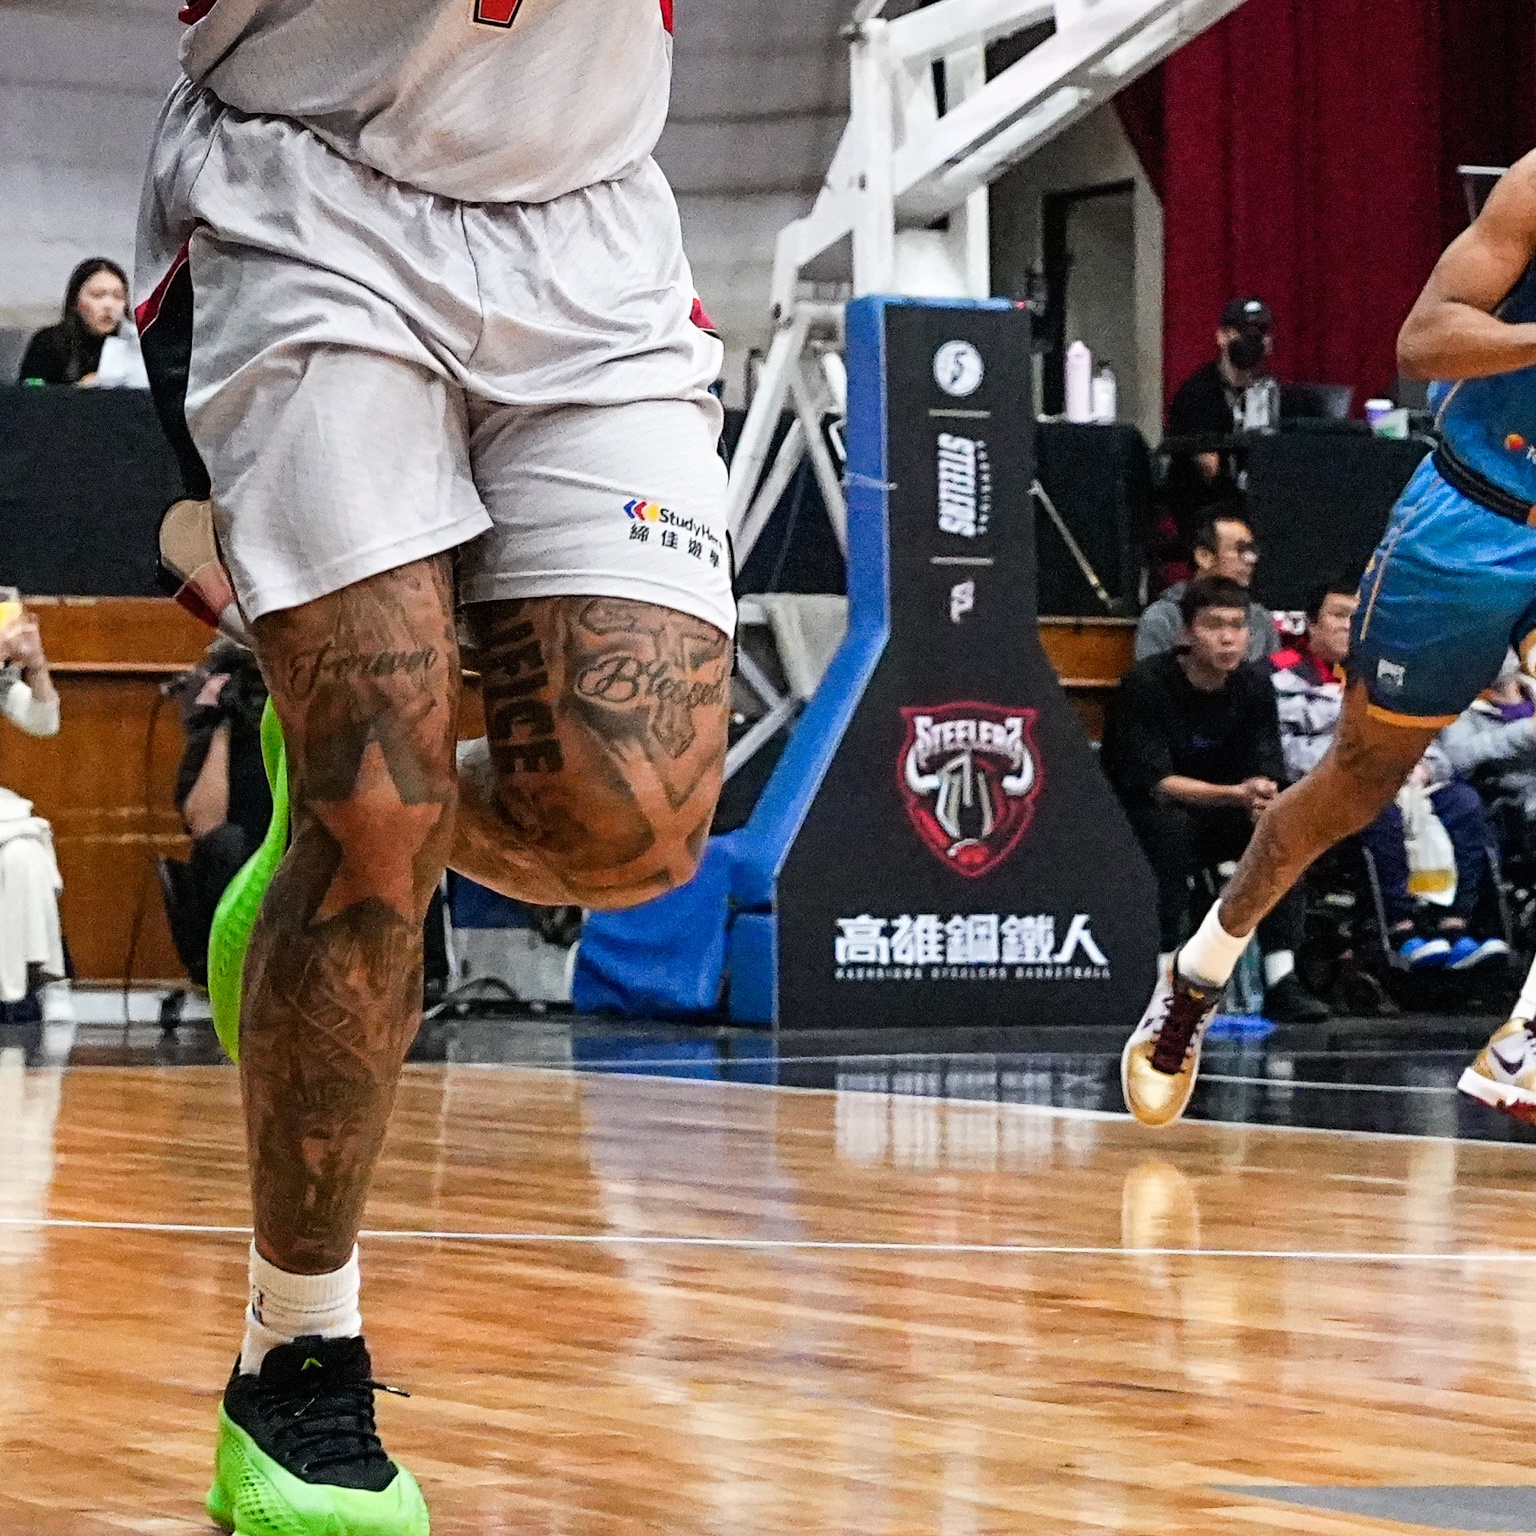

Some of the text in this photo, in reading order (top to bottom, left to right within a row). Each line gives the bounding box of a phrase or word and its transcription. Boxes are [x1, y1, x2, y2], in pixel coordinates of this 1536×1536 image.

[914, 715, 1024, 770] STEELERS
[834, 913, 1111, 965] 高雄鋼鐵人
